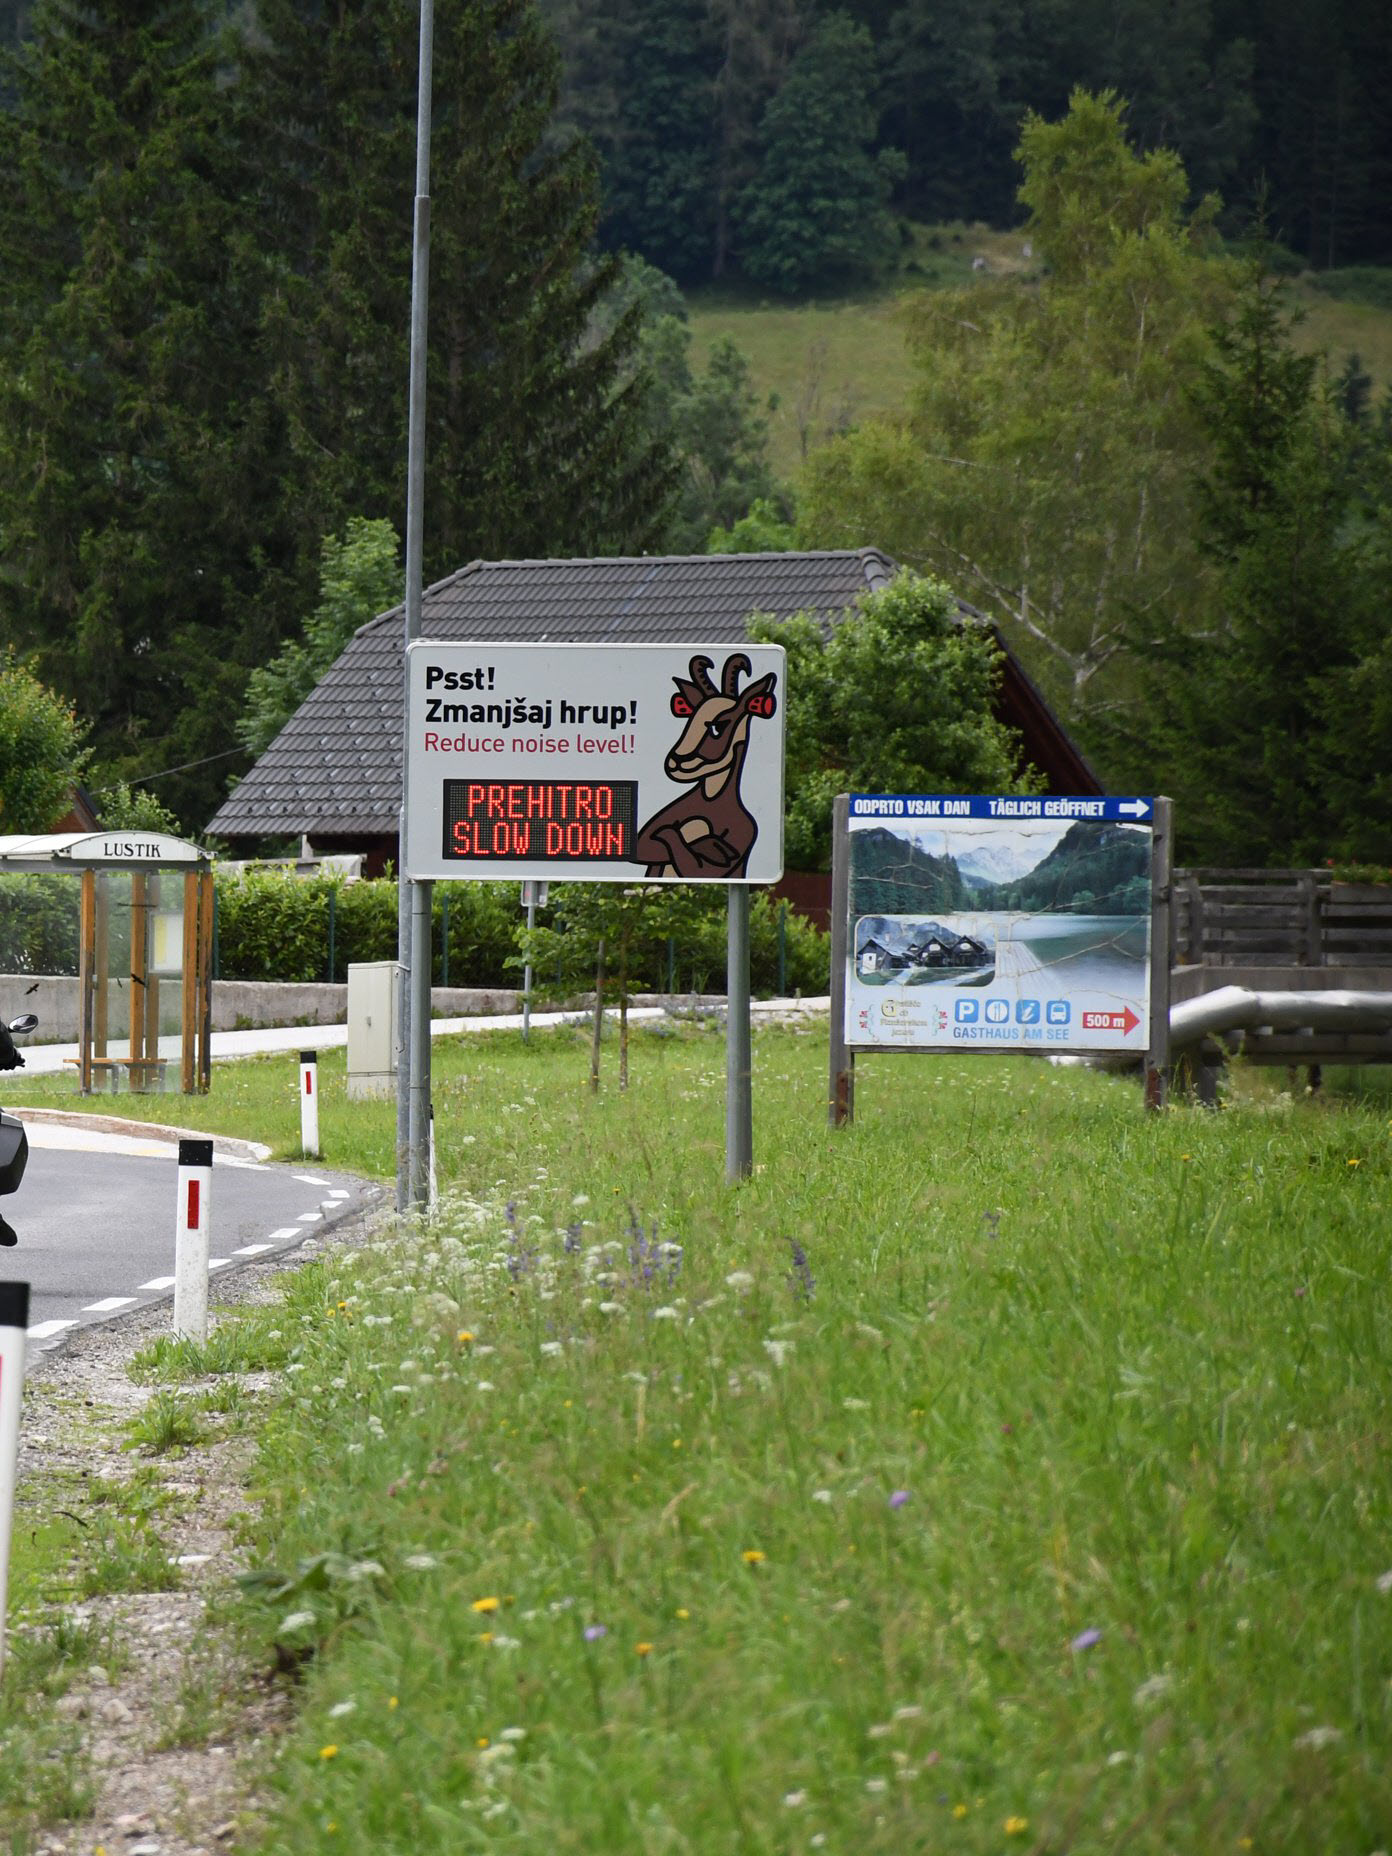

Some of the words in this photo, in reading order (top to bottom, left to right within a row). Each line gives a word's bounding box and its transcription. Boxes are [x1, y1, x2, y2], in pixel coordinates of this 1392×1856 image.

[426, 666, 495, 690] Psst!
[425, 697, 552, 729] Zmanjšaj
[560, 700, 637, 729] hrup!
[425, 733, 505, 753] Reduce
[512, 733, 570, 753] noise
[577, 734, 635, 754] level!
[467, 785, 612, 819] PREHITRO
[854, 800, 903, 815] ODPRTO
[907, 800, 940, 815] VSAK
[944, 801, 970, 815] DAN
[989, 798, 1041, 816] TÄGLICH
[1044, 798, 1105, 816] GEÖFFNET
[453, 820, 529, 855] SLOW
[546, 821, 623, 856] DOWN
[104, 842, 161, 858] LUSTIK
[1086, 1014, 1110, 1027] 500
[1113, 1017, 1125, 1027] m
[953, 1027, 1019, 1040] GASTHAUS
[1023, 1028, 1042, 1040] AM
[1046, 1028, 1069, 1040] SEE
